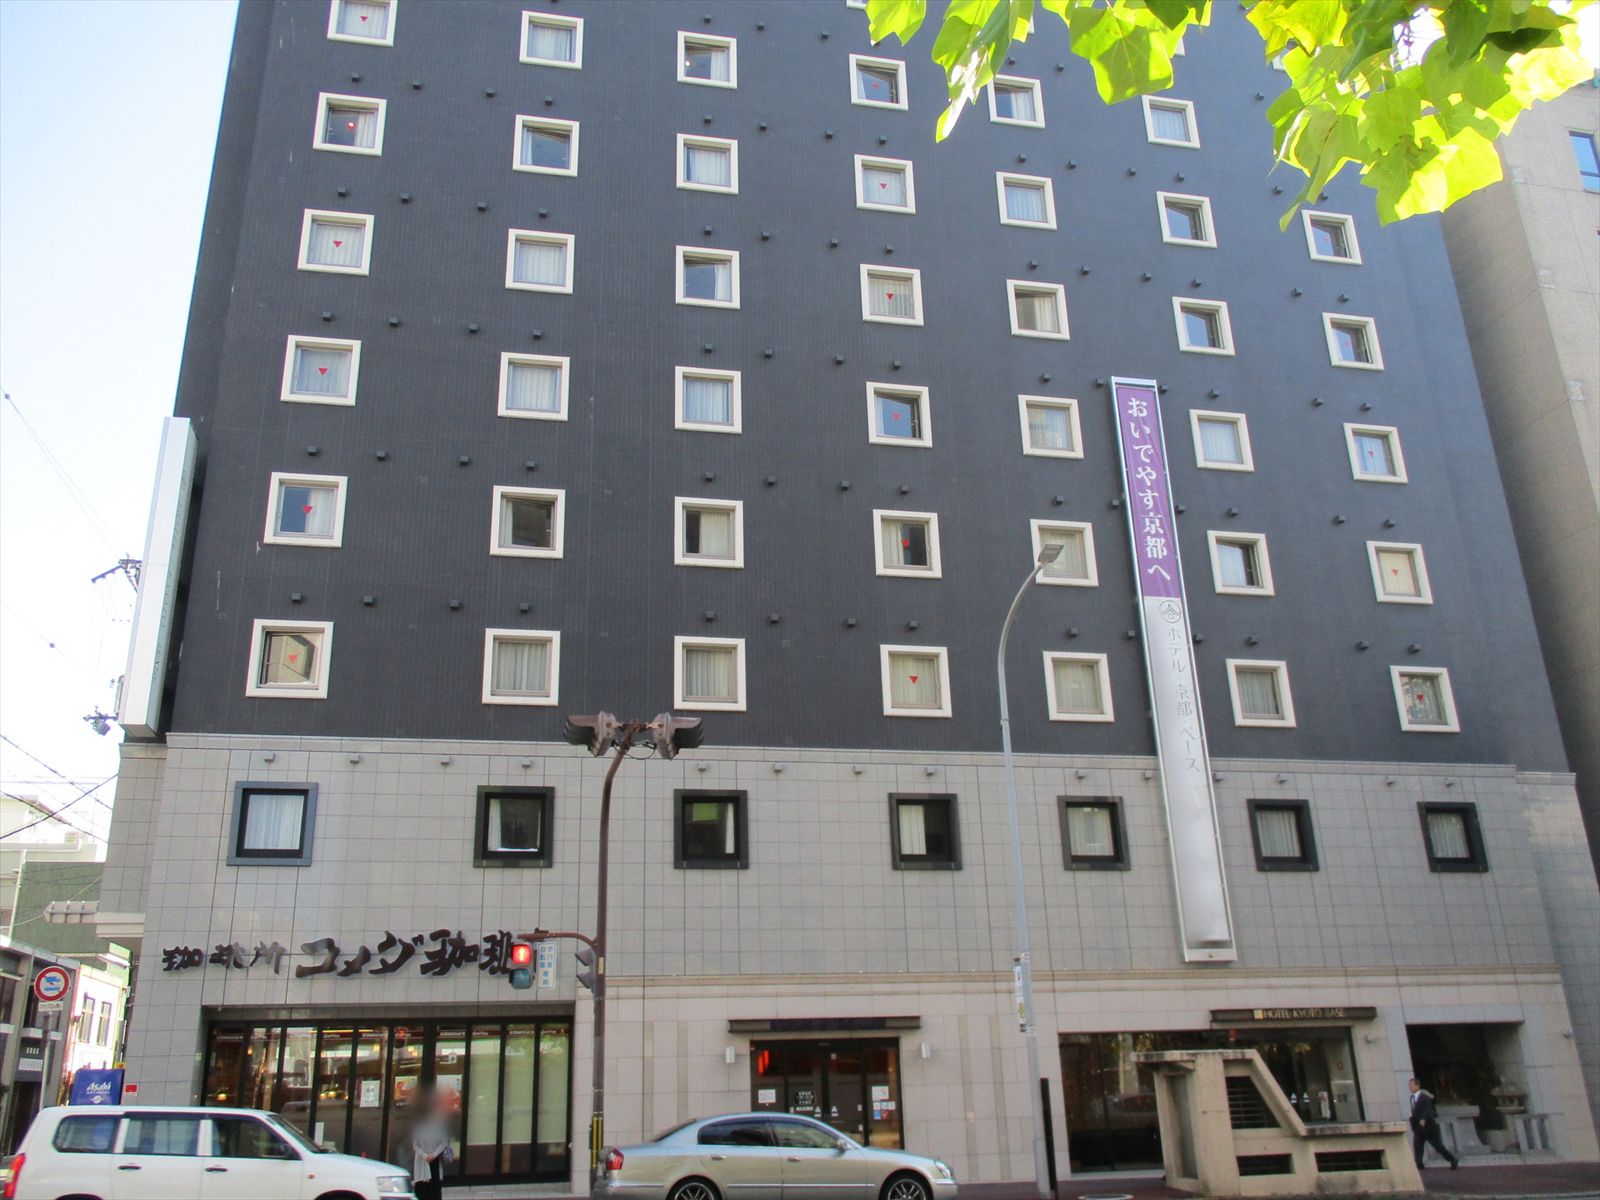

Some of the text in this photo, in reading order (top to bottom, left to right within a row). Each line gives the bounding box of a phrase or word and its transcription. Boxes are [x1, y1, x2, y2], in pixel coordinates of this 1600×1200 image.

[1127, 397, 1171, 581] おいでやす京都へ
[295, 928, 540, 978] コメダ珈琲
[1264, 1007, 1345, 1018] HOTEL KYOTO BASE
[86, 1081, 112, 1091] Asahi
